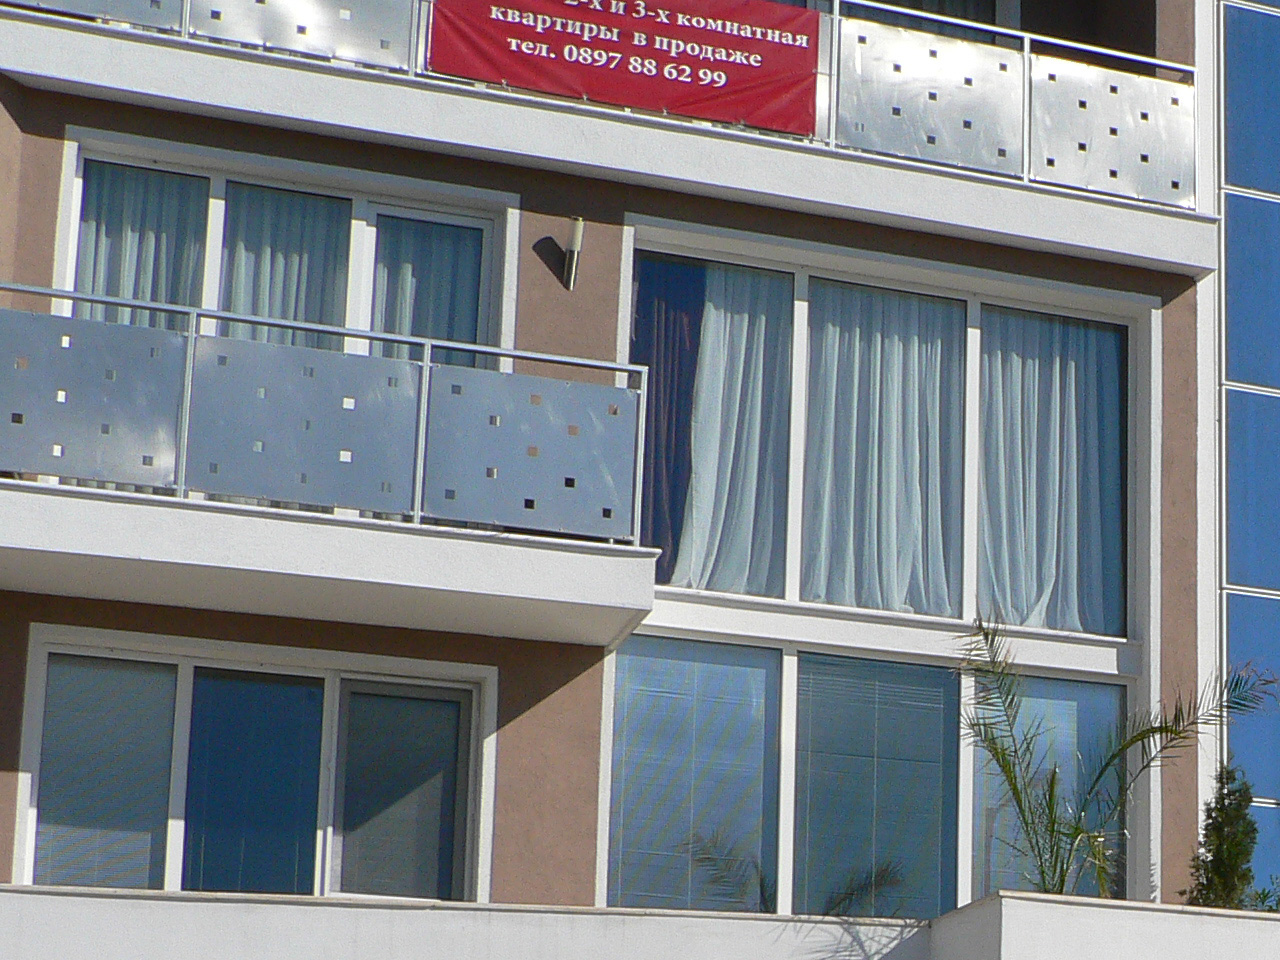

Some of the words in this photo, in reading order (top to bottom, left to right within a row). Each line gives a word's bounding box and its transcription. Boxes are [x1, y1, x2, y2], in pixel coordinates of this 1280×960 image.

[489, 5, 620, 42] квартиры
[632, 31, 648, 46] в
[654, 35, 762, 66] продаже
[564, 0, 604, 11] -х
[610, 0, 627, 15] и
[632, 0, 670, 24] 3-х
[676, 12, 809, 48] комнатная
[506, 37, 556, 58] тел.
[563, 44, 622, 69] 0897
[628, 56, 657, 76] 88
[663, 63, 692, 83] 62
[698, 68, 727, 88] 99
